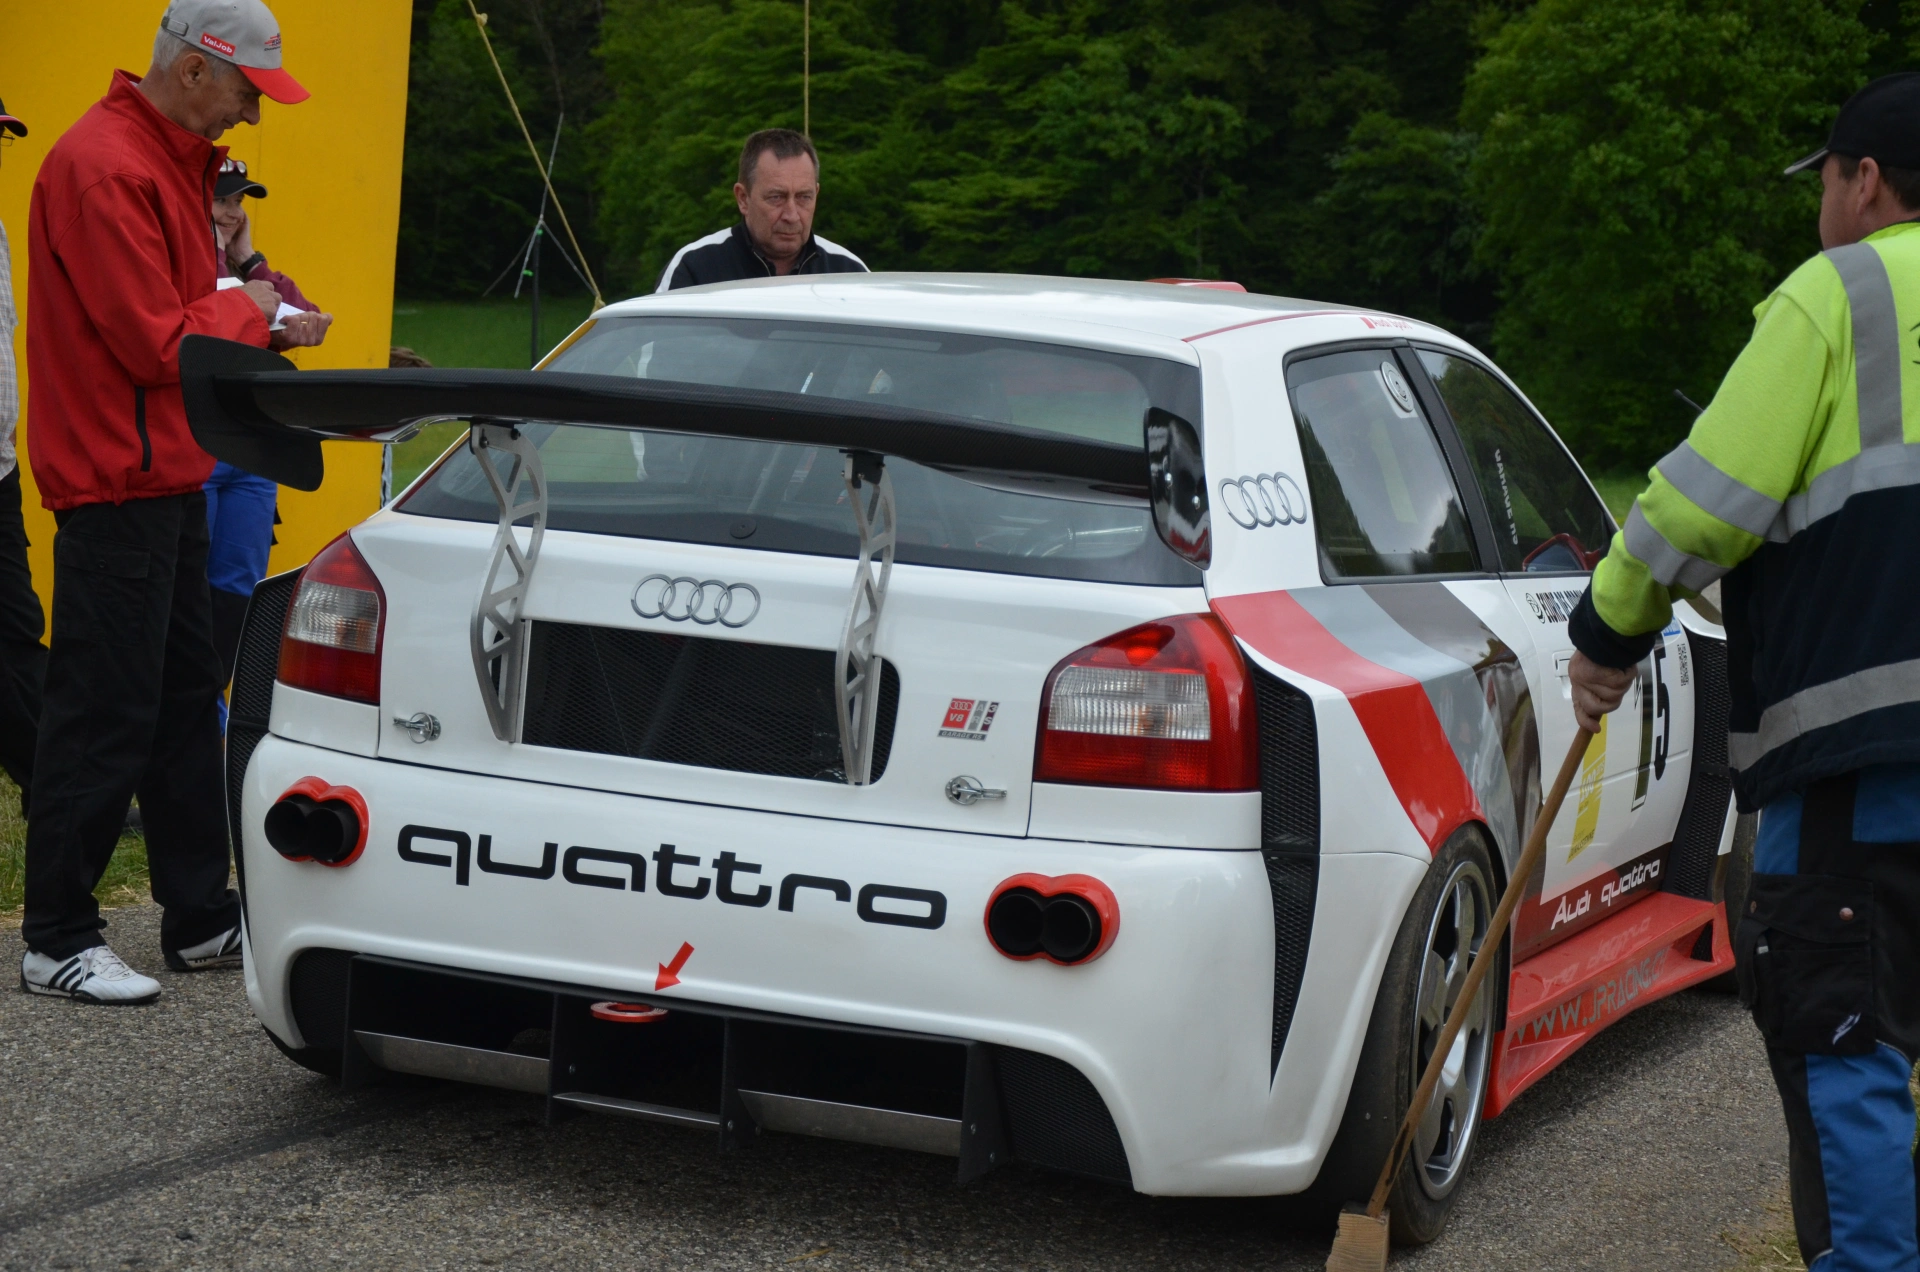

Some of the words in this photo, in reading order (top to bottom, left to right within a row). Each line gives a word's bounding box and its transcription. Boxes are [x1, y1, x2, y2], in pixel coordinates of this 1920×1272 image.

[203, 35, 233, 53] ValJob
[949, 713, 964, 722] V8
[941, 730, 971, 739] GARAGE
[972, 732, 983, 740] RS
[396, 823, 948, 931] quattro
[1551, 889, 1592, 931] Audi
[1600, 858, 1661, 908] quattro
